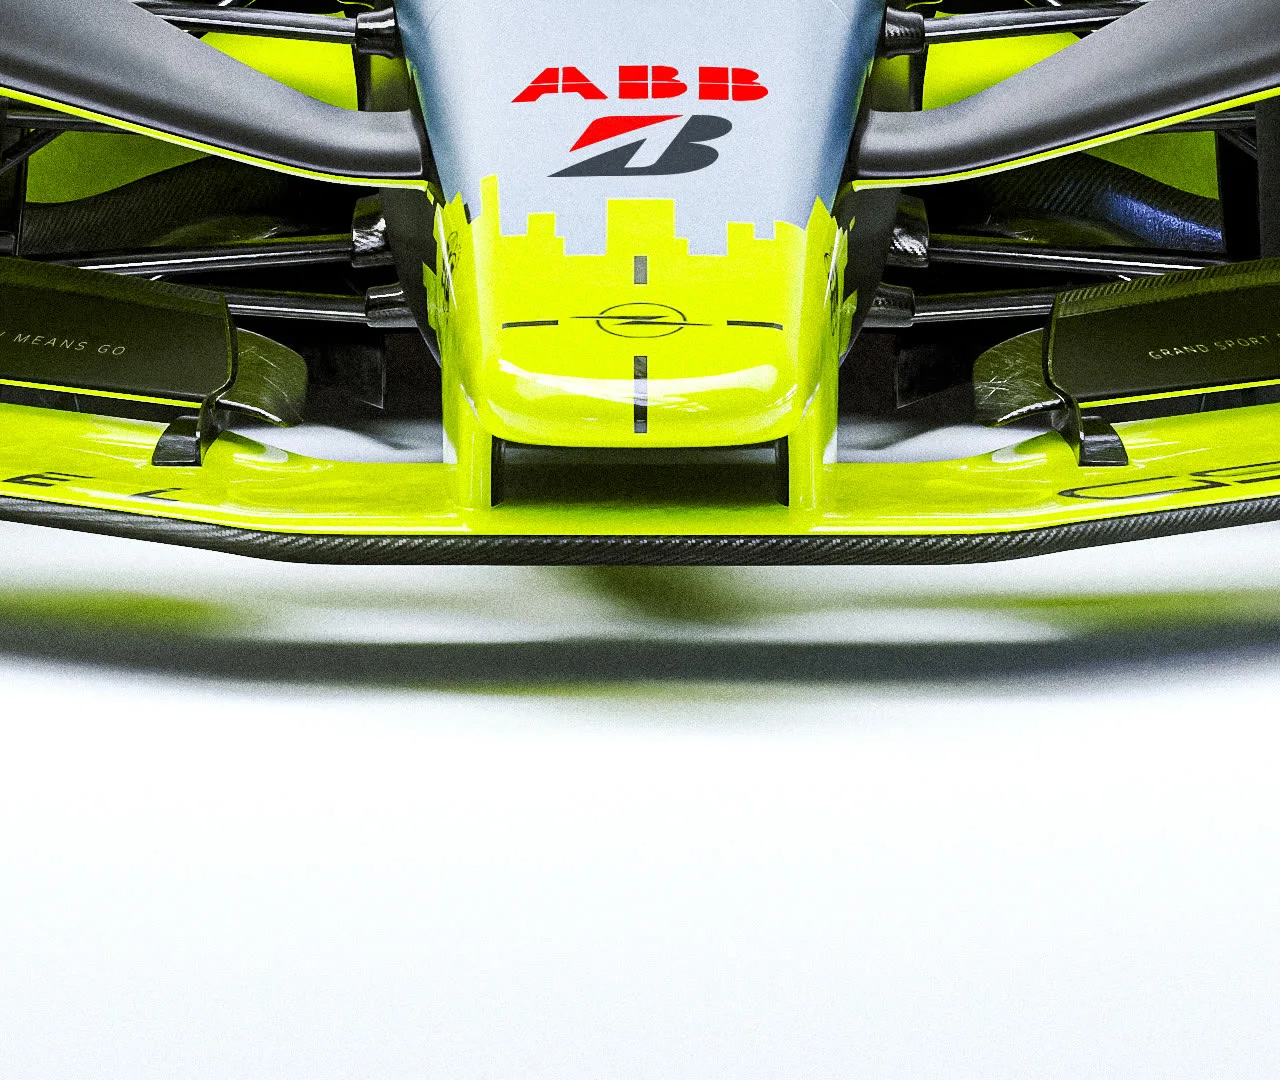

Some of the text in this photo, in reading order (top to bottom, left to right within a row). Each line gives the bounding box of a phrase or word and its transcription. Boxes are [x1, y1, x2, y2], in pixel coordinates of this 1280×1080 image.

[511, 65, 768, 102] ABB
[13, 333, 87, 351] MEANS
[97, 345, 126, 356] GO
[1148, 344, 1209, 360] GRAND
[1213, 335, 1270, 351] SPORT
